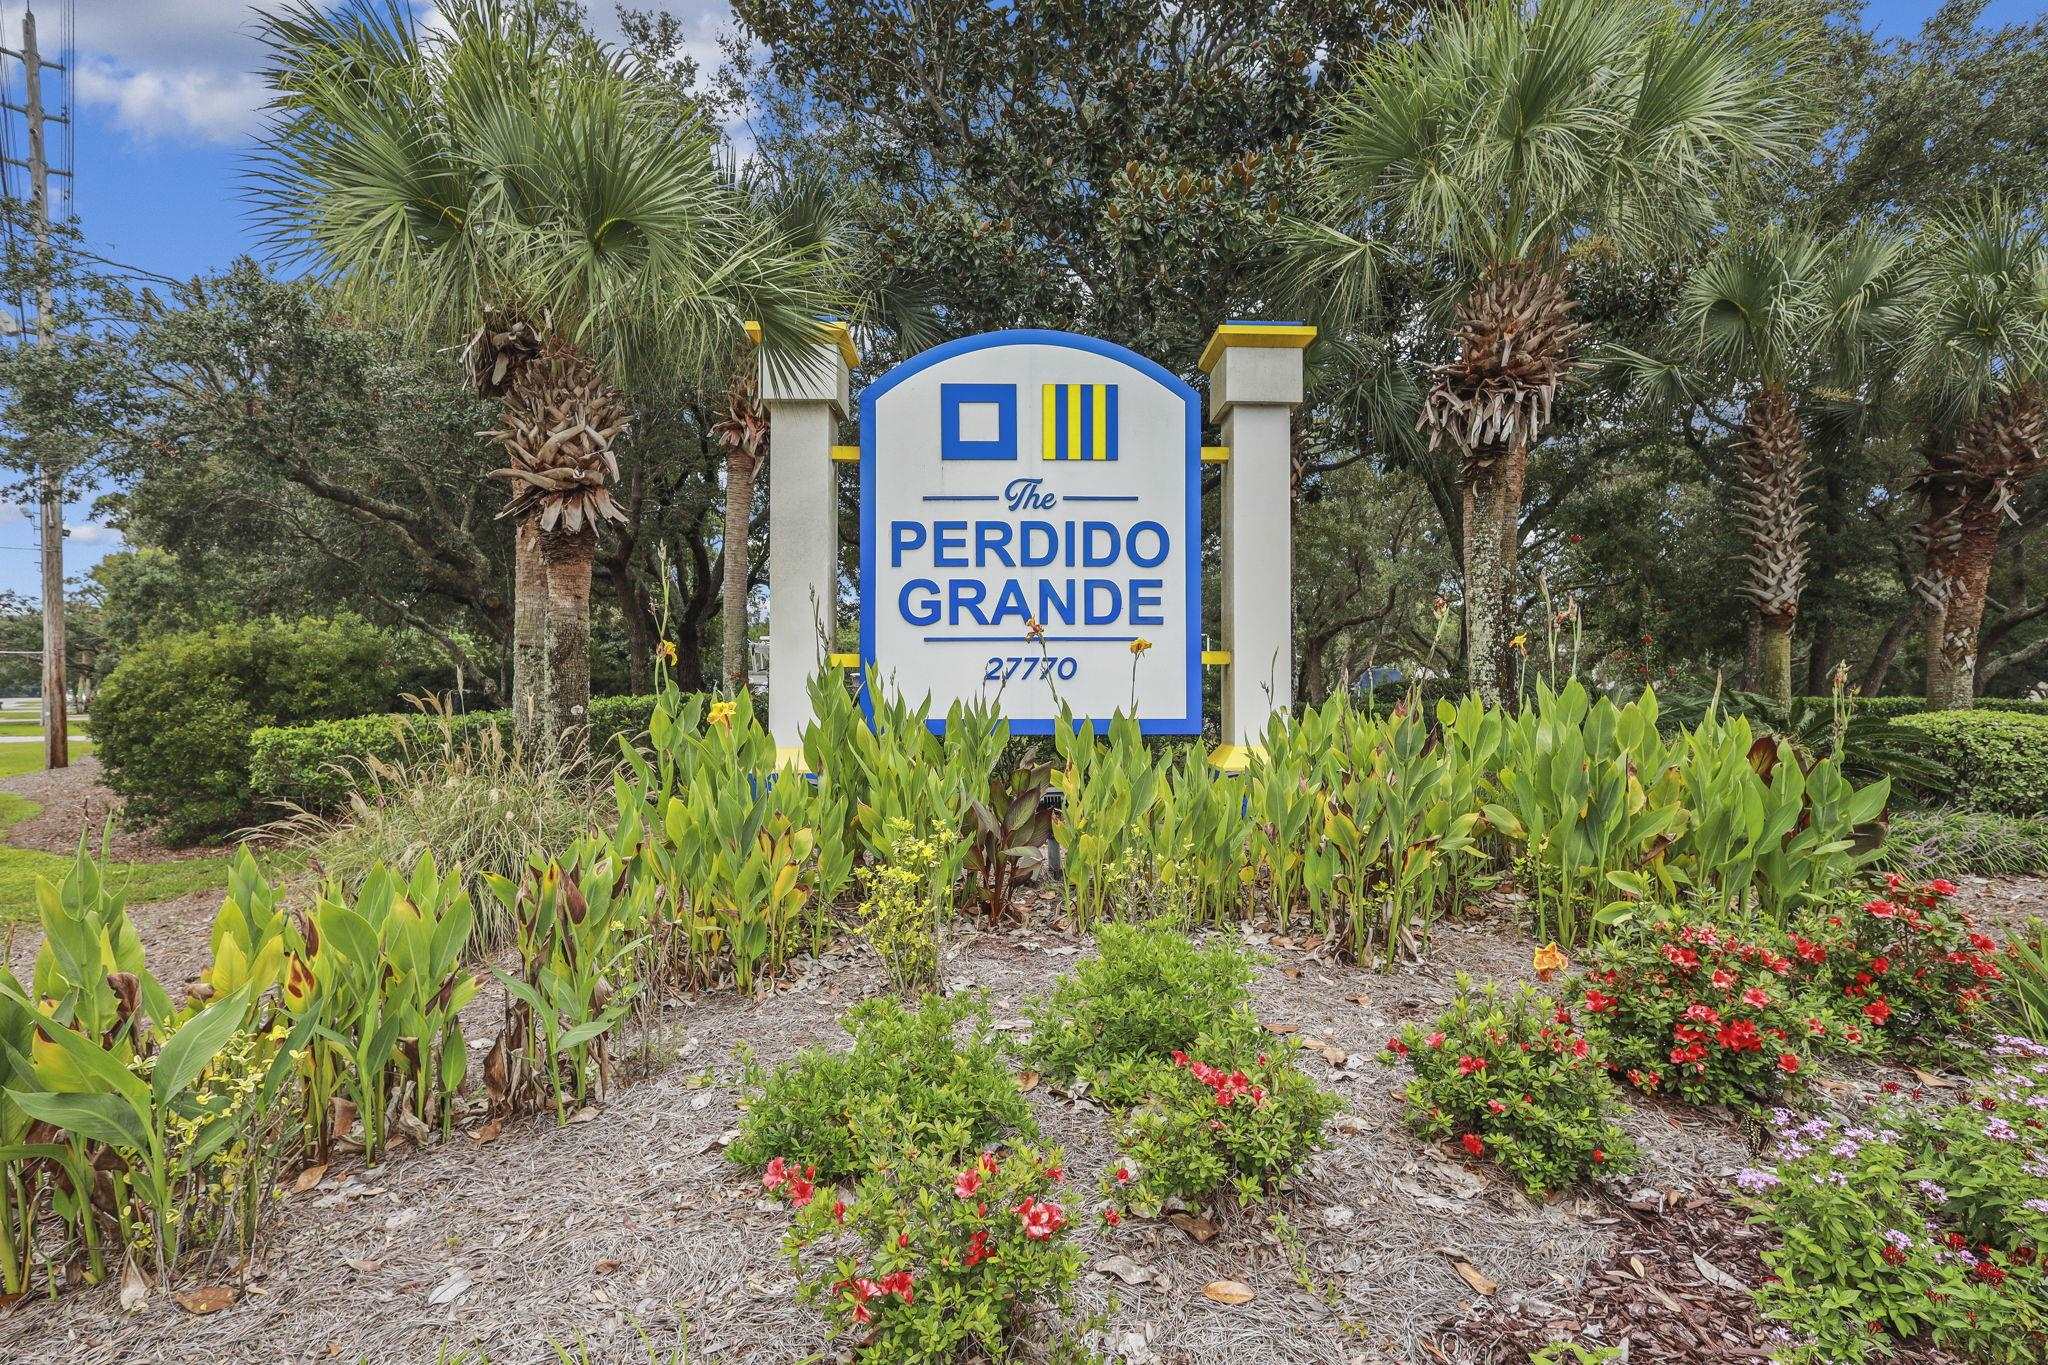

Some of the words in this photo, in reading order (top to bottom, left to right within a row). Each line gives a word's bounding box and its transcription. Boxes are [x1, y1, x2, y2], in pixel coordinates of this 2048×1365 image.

[1004, 477, 1057, 512] The
[890, 520, 1171, 568] PERDIDO
[898, 578, 1164, 627] GRANDE
[985, 656, 1078, 681] 27770
